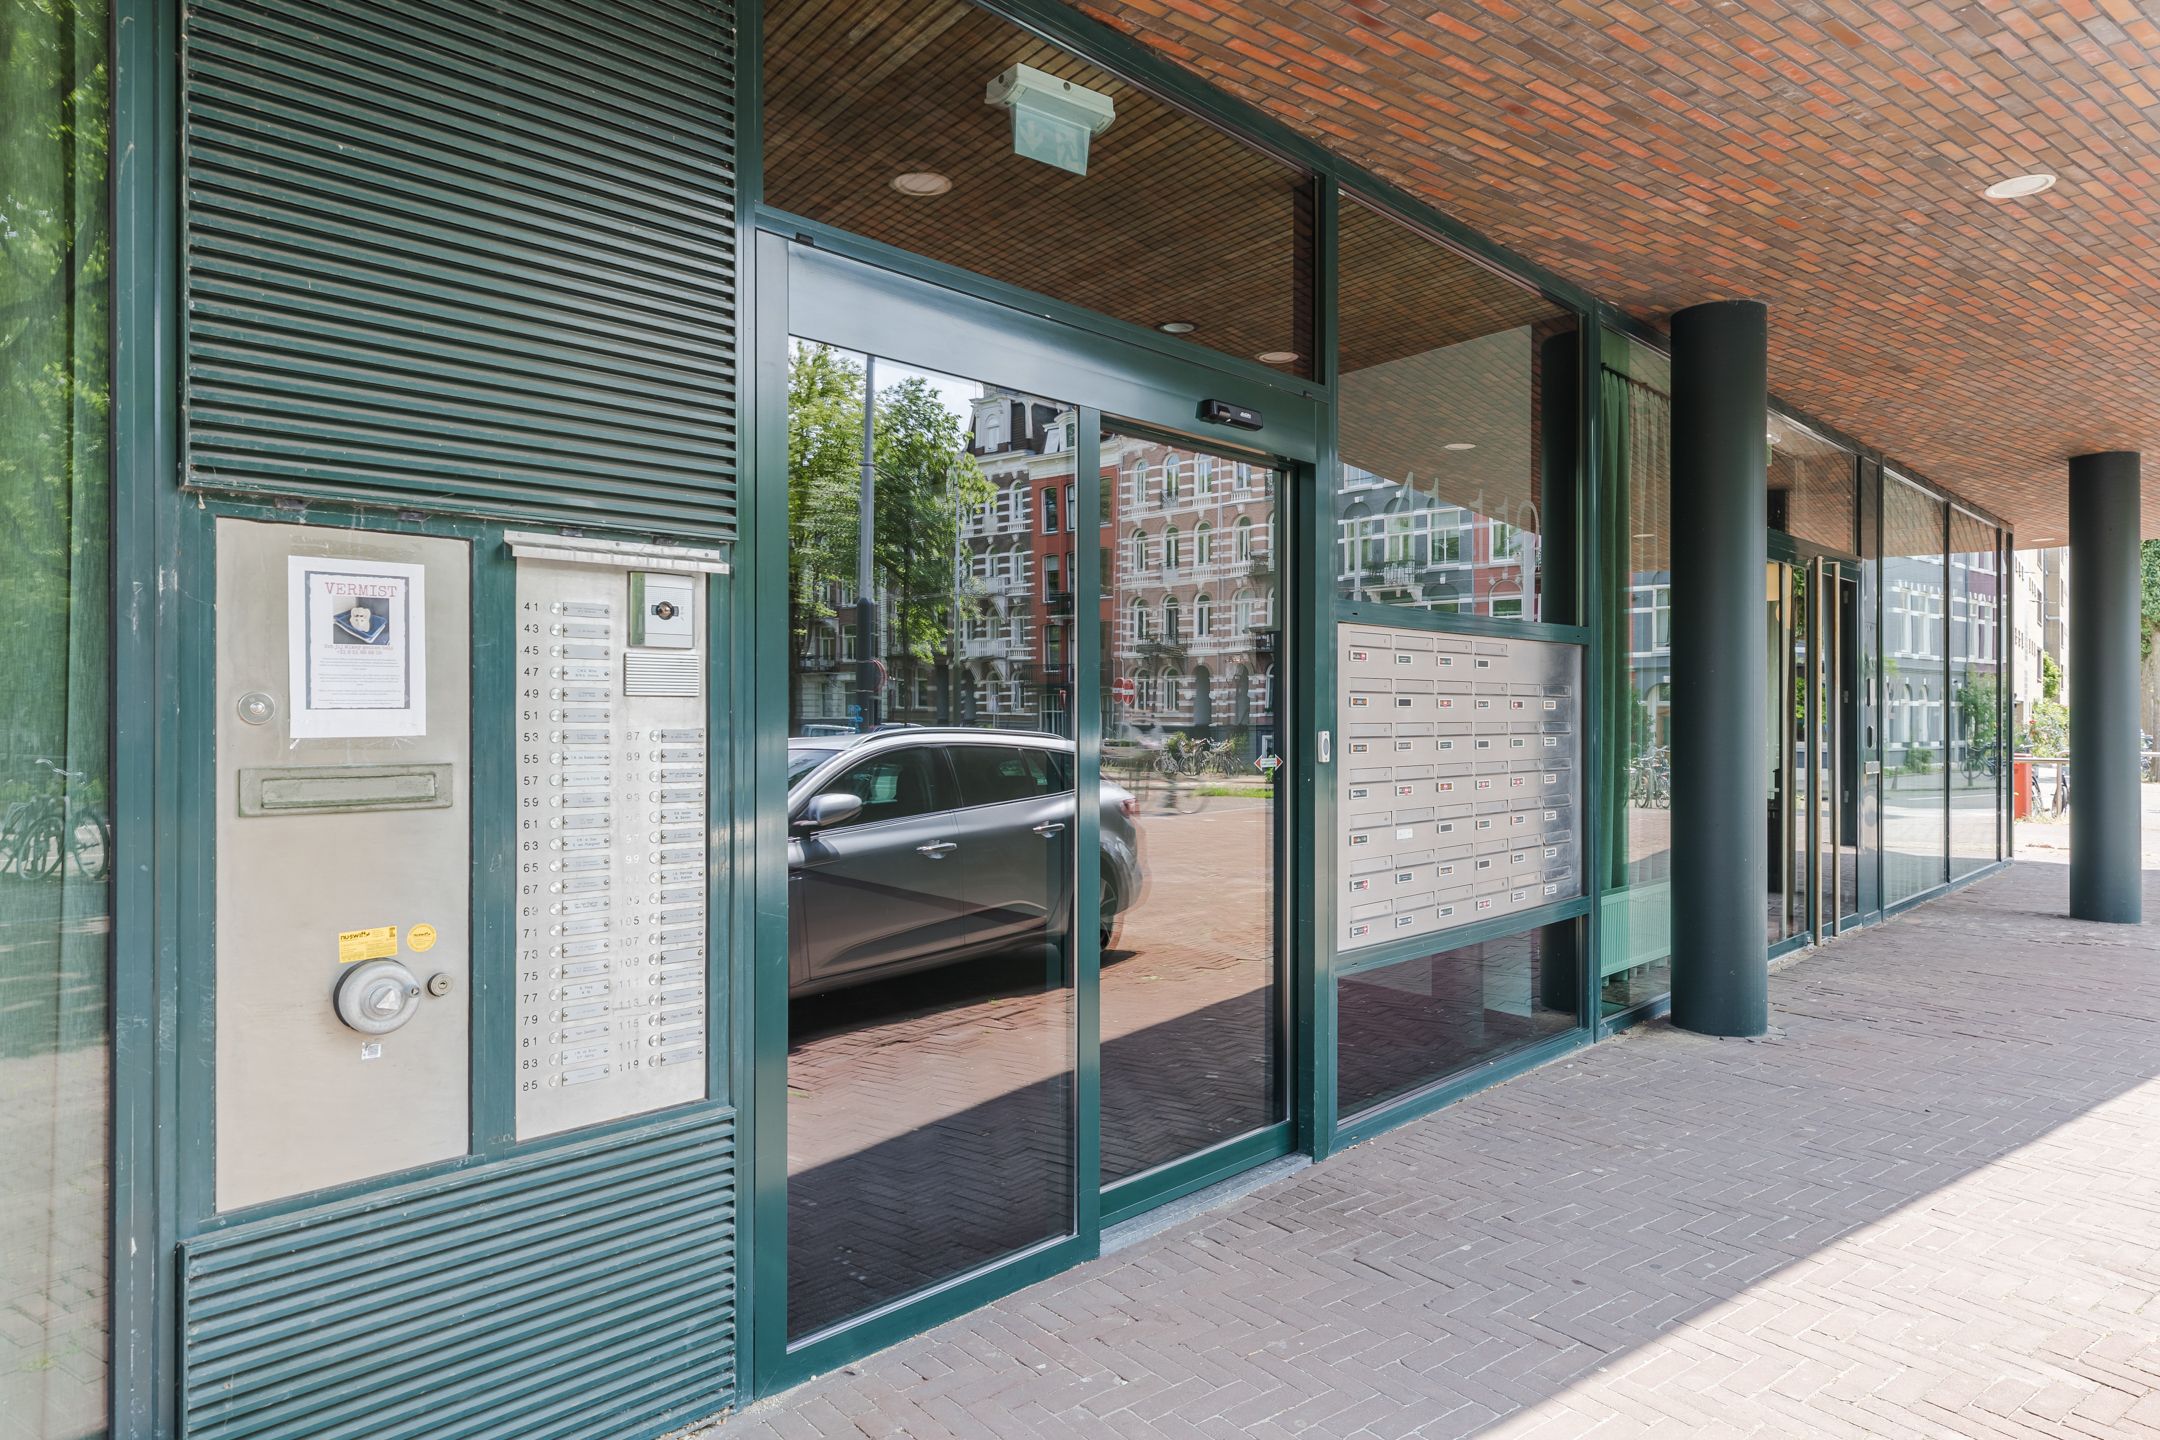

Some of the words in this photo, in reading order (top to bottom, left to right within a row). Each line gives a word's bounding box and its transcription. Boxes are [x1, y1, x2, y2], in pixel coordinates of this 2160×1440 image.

[325, 582, 397, 597] VERMIST
[523, 602, 539, 611] 41
[523, 624, 539, 633] 43
[523, 646, 539, 655] 45
[523, 667, 539, 676] 47
[523, 689, 539, 698] 49
[523, 711, 539, 720] 51
[523, 732, 539, 742] 53
[626, 732, 640, 740] 87
[523, 754, 539, 764] 55
[626, 752, 640, 761] 89
[523, 776, 539, 786] 57
[523, 797, 539, 807] 59
[523, 820, 539, 829] 61
[523, 841, 539, 851] 63
[625, 855, 640, 864] 99
[523, 863, 539, 872] 65
[523, 884, 539, 894] 67
[523, 928, 539, 938] 71
[523, 950, 539, 960] 73
[523, 971, 539, 982] 75
[523, 993, 539, 1003] 77
[523, 1015, 539, 1025] 79
[523, 1036, 539, 1047] 81
[523, 1058, 539, 1069] 83
[619, 1060, 639, 1072] 119
[523, 1080, 539, 1091] 85
